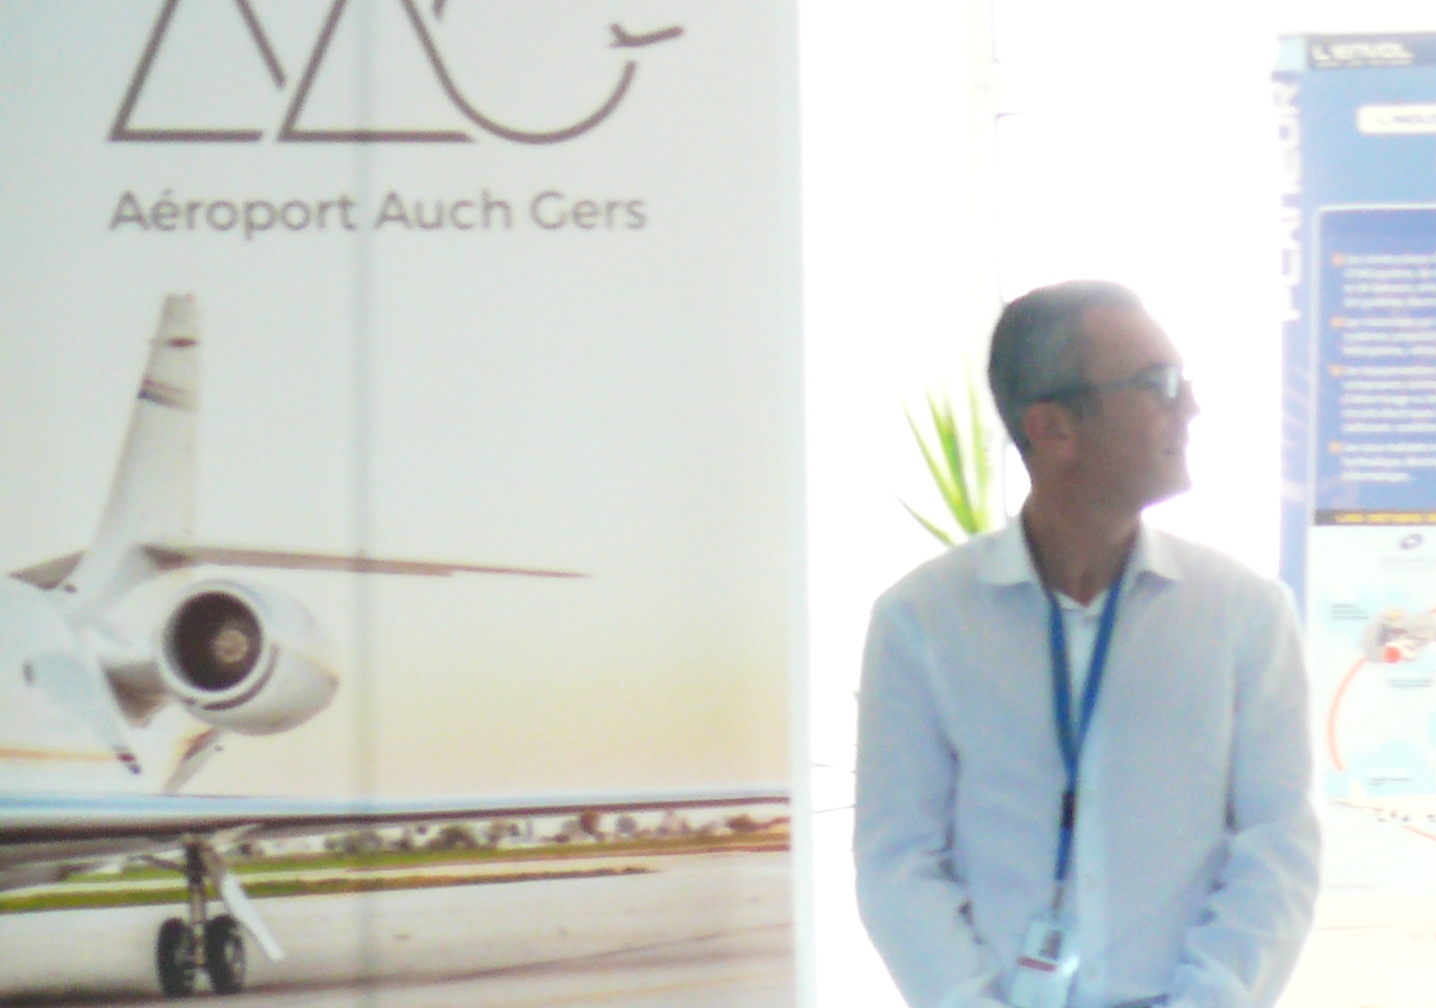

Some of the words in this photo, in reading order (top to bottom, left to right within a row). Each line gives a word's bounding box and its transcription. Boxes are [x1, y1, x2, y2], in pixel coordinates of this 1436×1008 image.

[109, 189, 358, 240] Aéroport
[374, 190, 514, 232] Auch
[530, 190, 649, 232] Gers
